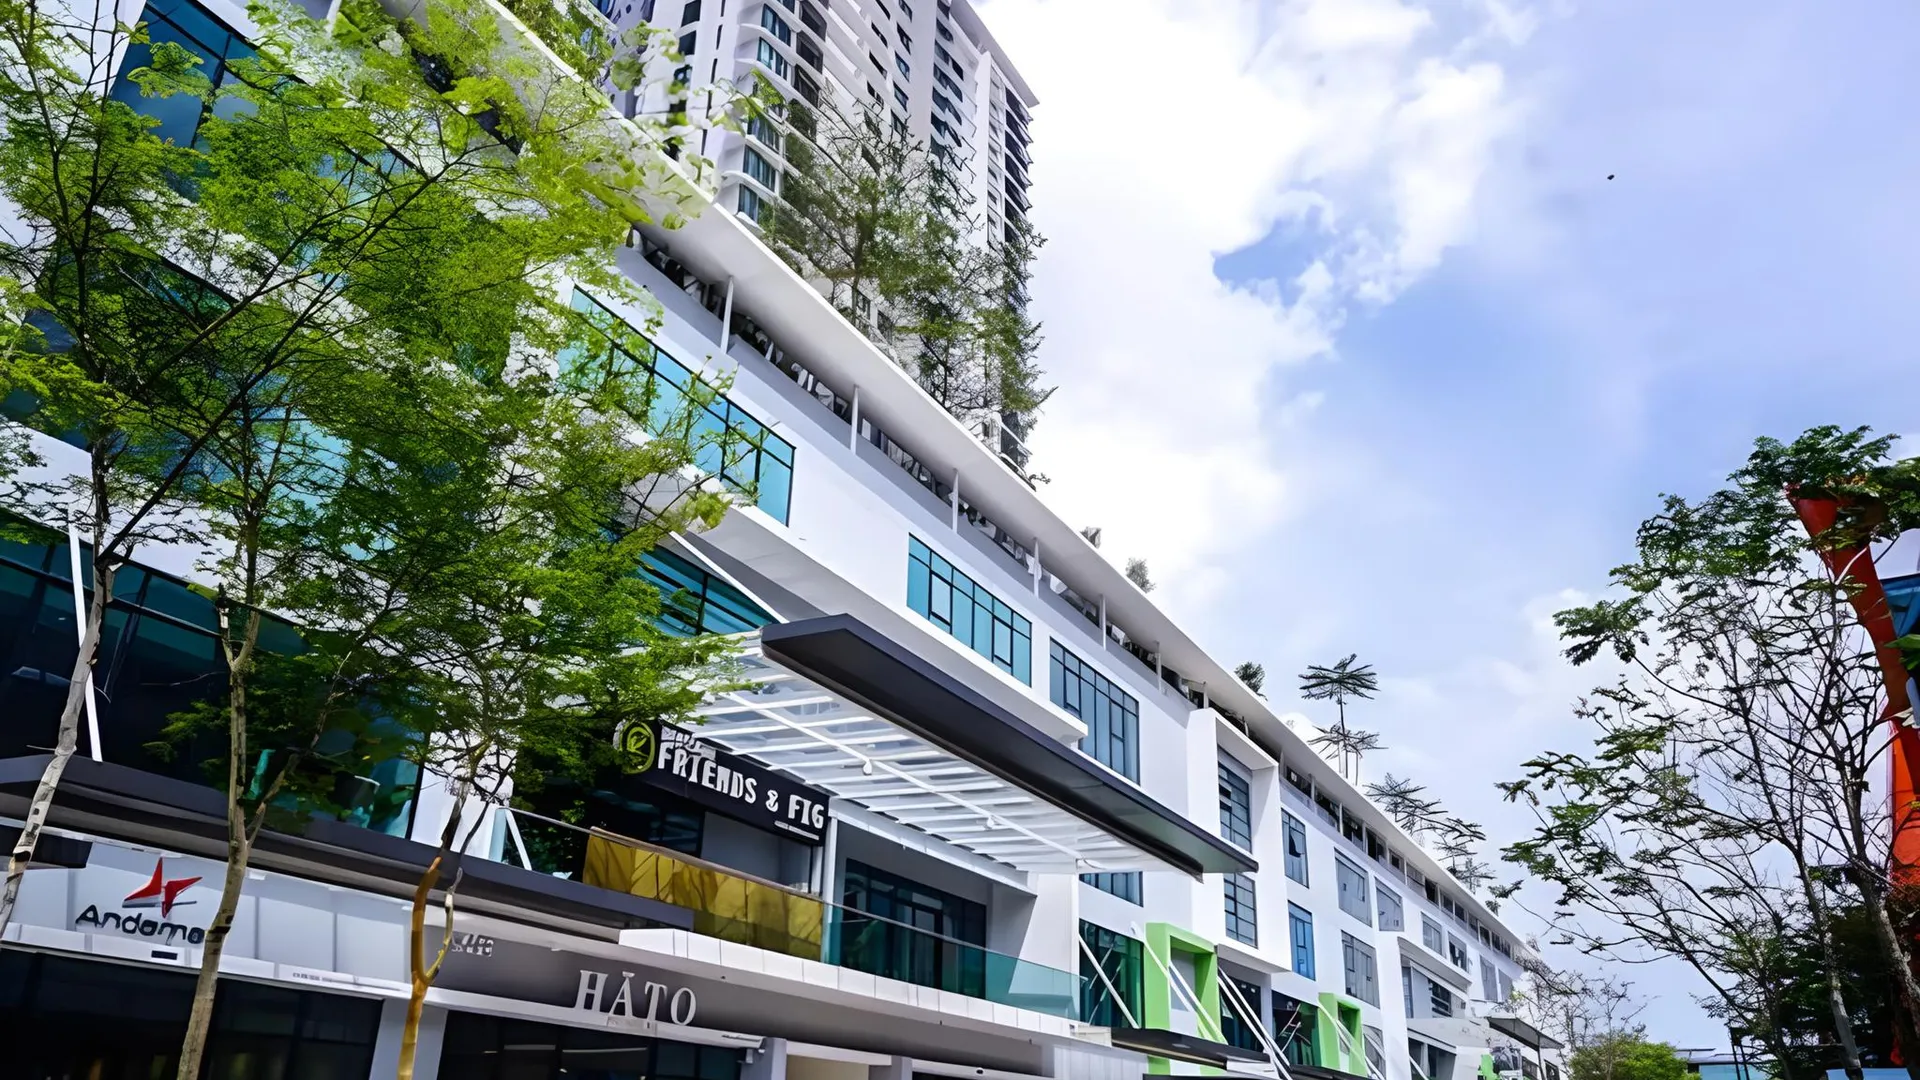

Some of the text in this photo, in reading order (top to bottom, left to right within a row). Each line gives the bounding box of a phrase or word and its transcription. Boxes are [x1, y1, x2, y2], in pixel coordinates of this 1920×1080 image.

[658, 741, 757, 804] FRIENDS
[765, 789, 779, 813] &
[787, 794, 825, 829] FIG
